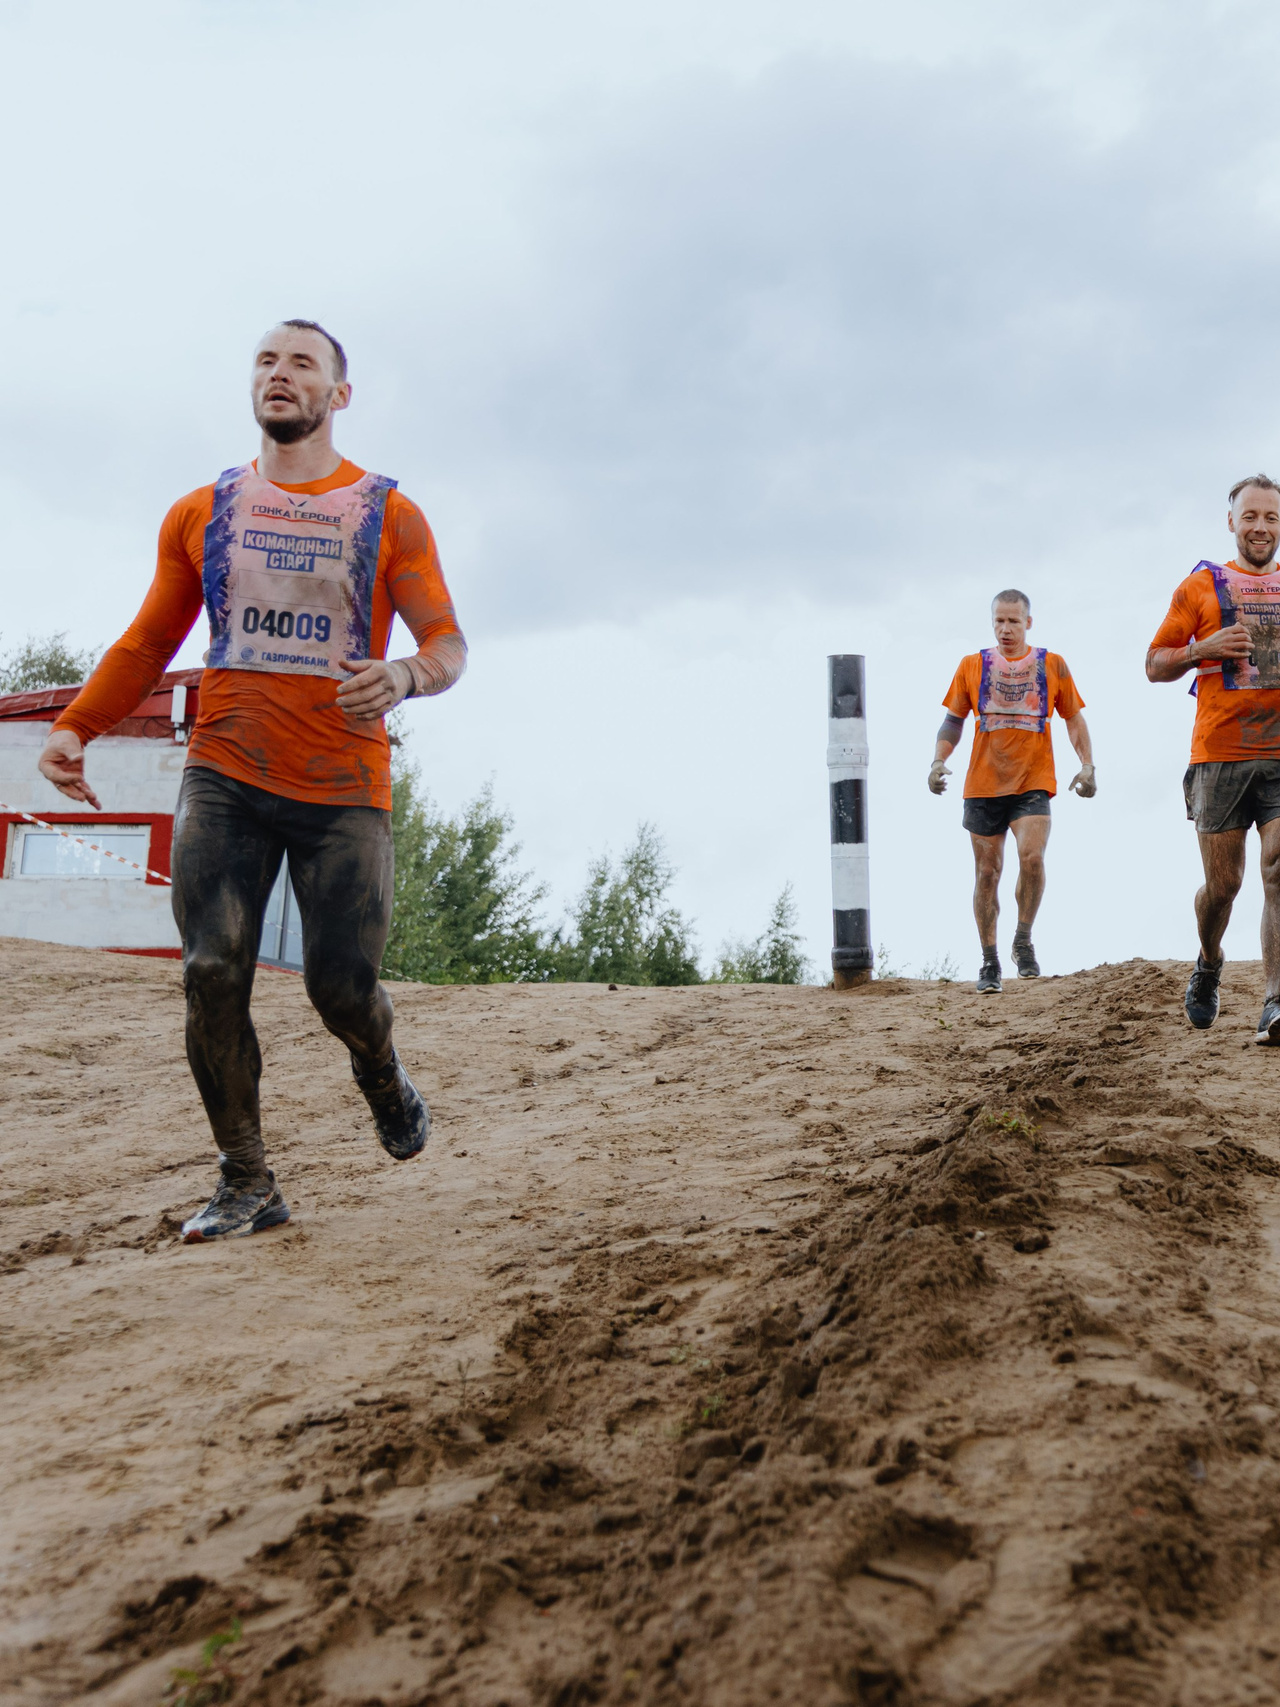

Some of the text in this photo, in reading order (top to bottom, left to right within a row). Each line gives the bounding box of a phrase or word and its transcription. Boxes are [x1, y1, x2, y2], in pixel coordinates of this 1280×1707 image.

[252, 505, 341, 524] ГОНКА ГЕРОЕВ
[244, 532, 341, 556] КОМАНДНЫЙ
[269, 552, 312, 570] СТАРТ
[242, 606, 331, 642] 04009
[261, 651, 330, 667] ГАЗПРОМБАНК
